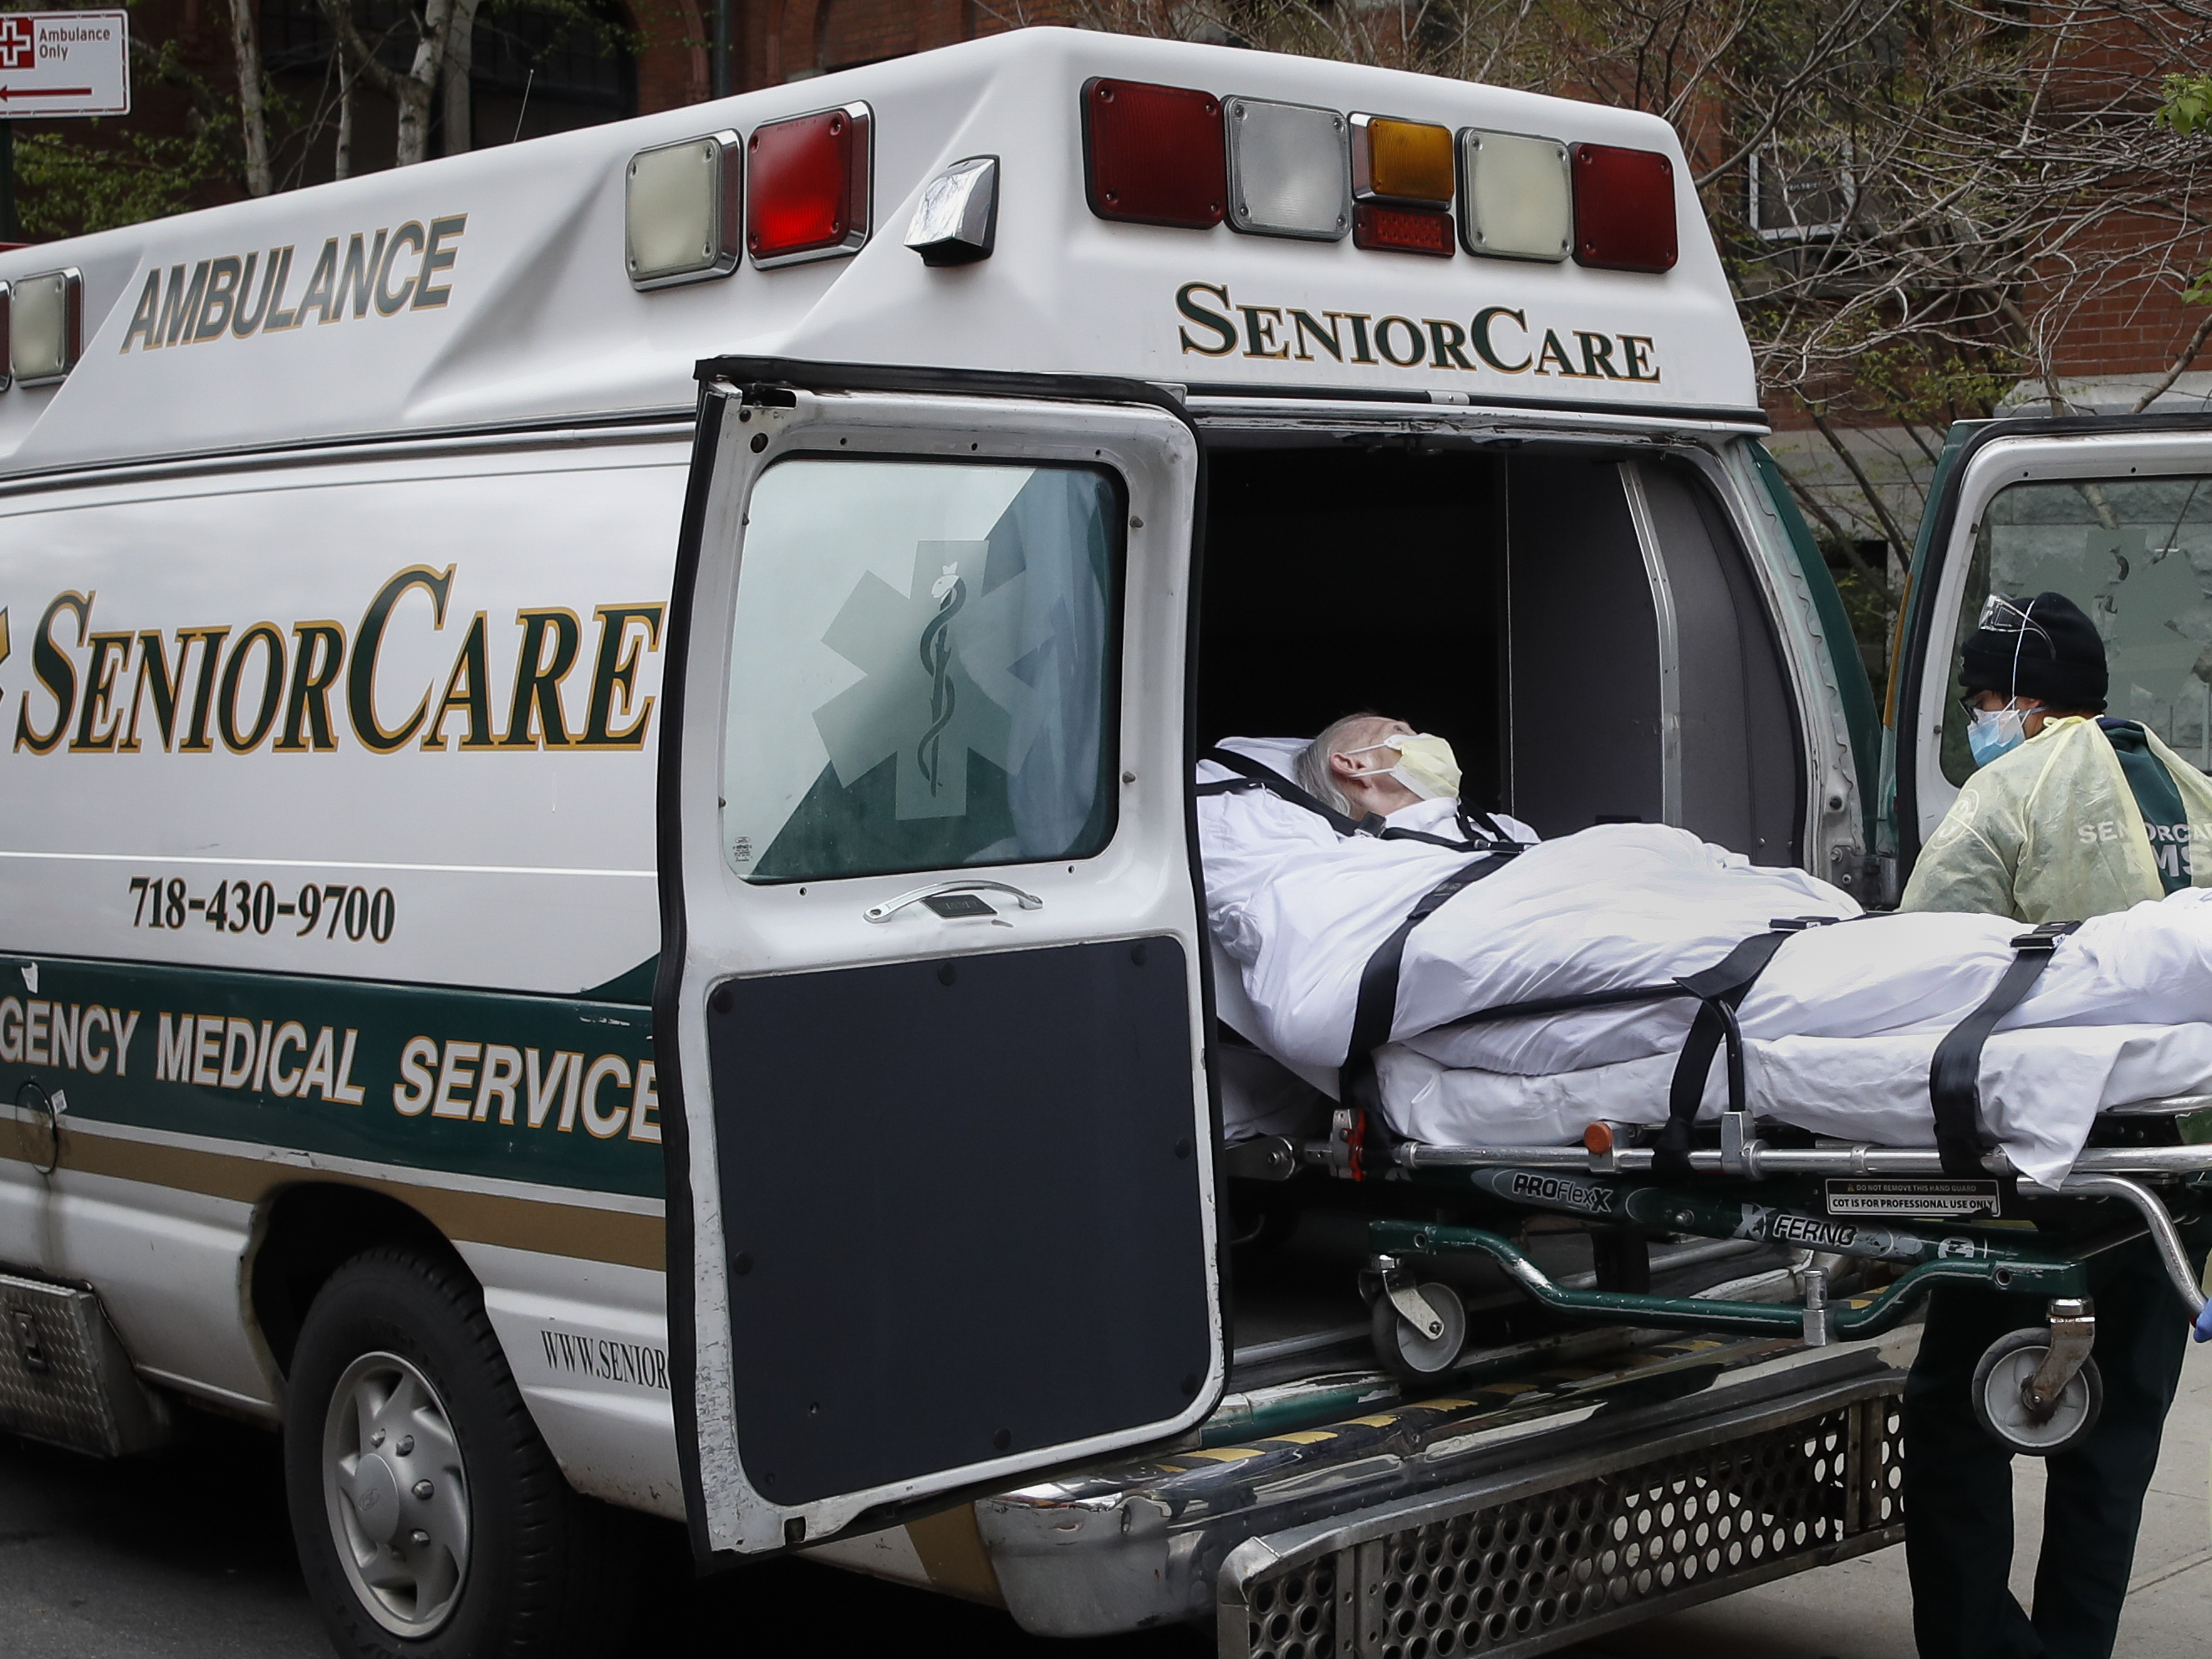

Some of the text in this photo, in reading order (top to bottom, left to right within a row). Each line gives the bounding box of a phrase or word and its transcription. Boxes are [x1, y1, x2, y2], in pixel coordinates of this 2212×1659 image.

[39, 27, 110, 42] Ambulance
[39, 44, 69, 61] Only
[119, 213, 468, 355] AMBULANCE
[129, 876, 396, 944] 718-430-9700
[0, 995, 663, 1144] GENCY MEDICAL SERVICE
[1832, 1198, 1994, 1209] COT IS FOR PROFESSIONAL USE ONLY
[1883, 1184, 1912, 1192] REMOVE
[1772, 1214, 1858, 1248] FERNO
[540, 1330, 669, 1390] WWW.SENIOR
